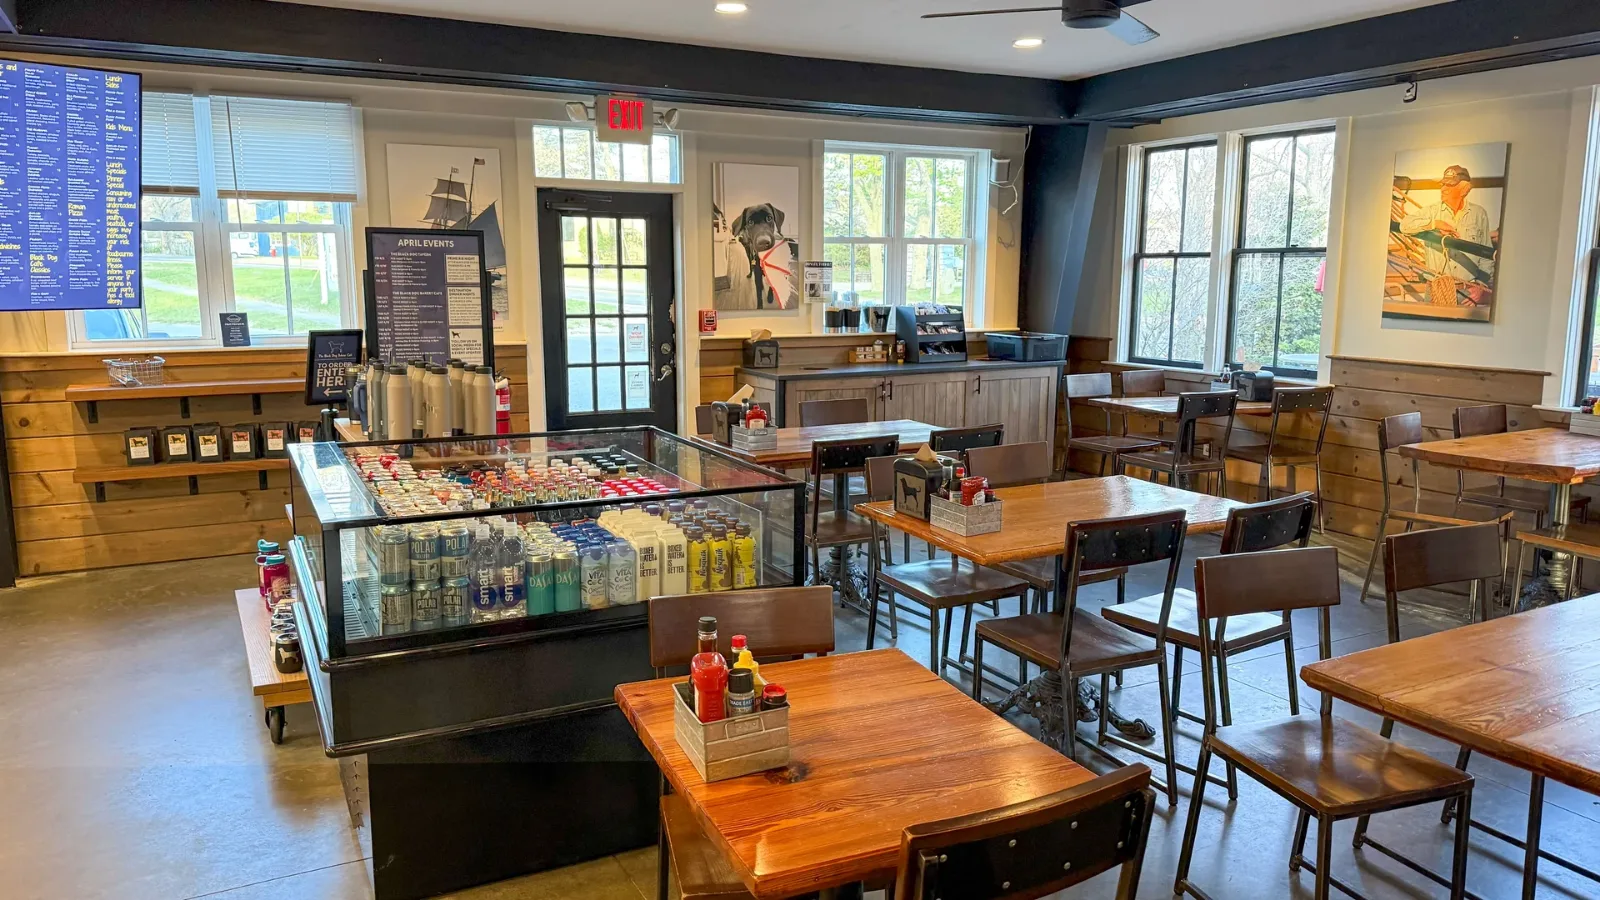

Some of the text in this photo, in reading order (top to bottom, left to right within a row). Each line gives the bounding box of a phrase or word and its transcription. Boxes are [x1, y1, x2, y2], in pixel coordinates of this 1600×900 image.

[105, 74, 122, 82] Lunch
[608, 98, 645, 131] EXIT
[118, 124, 133, 132] Menu
[106, 189, 132, 198] Consuming
[67, 203, 86, 211] Roman
[398, 239, 455, 248] APRIL EVENTS
[30, 253, 58, 263] Black Dog
[317, 367, 345, 377] ENTE
[316, 376, 347, 387] HER
[411, 540, 436, 553] POLAR
[588, 571, 606, 580] VITA
[615, 568, 632, 576] VITA
[502, 565, 514, 601] smart
[529, 573, 553, 589] DASA
[555, 572, 578, 586] DASA
[477, 568, 490, 605] smart
